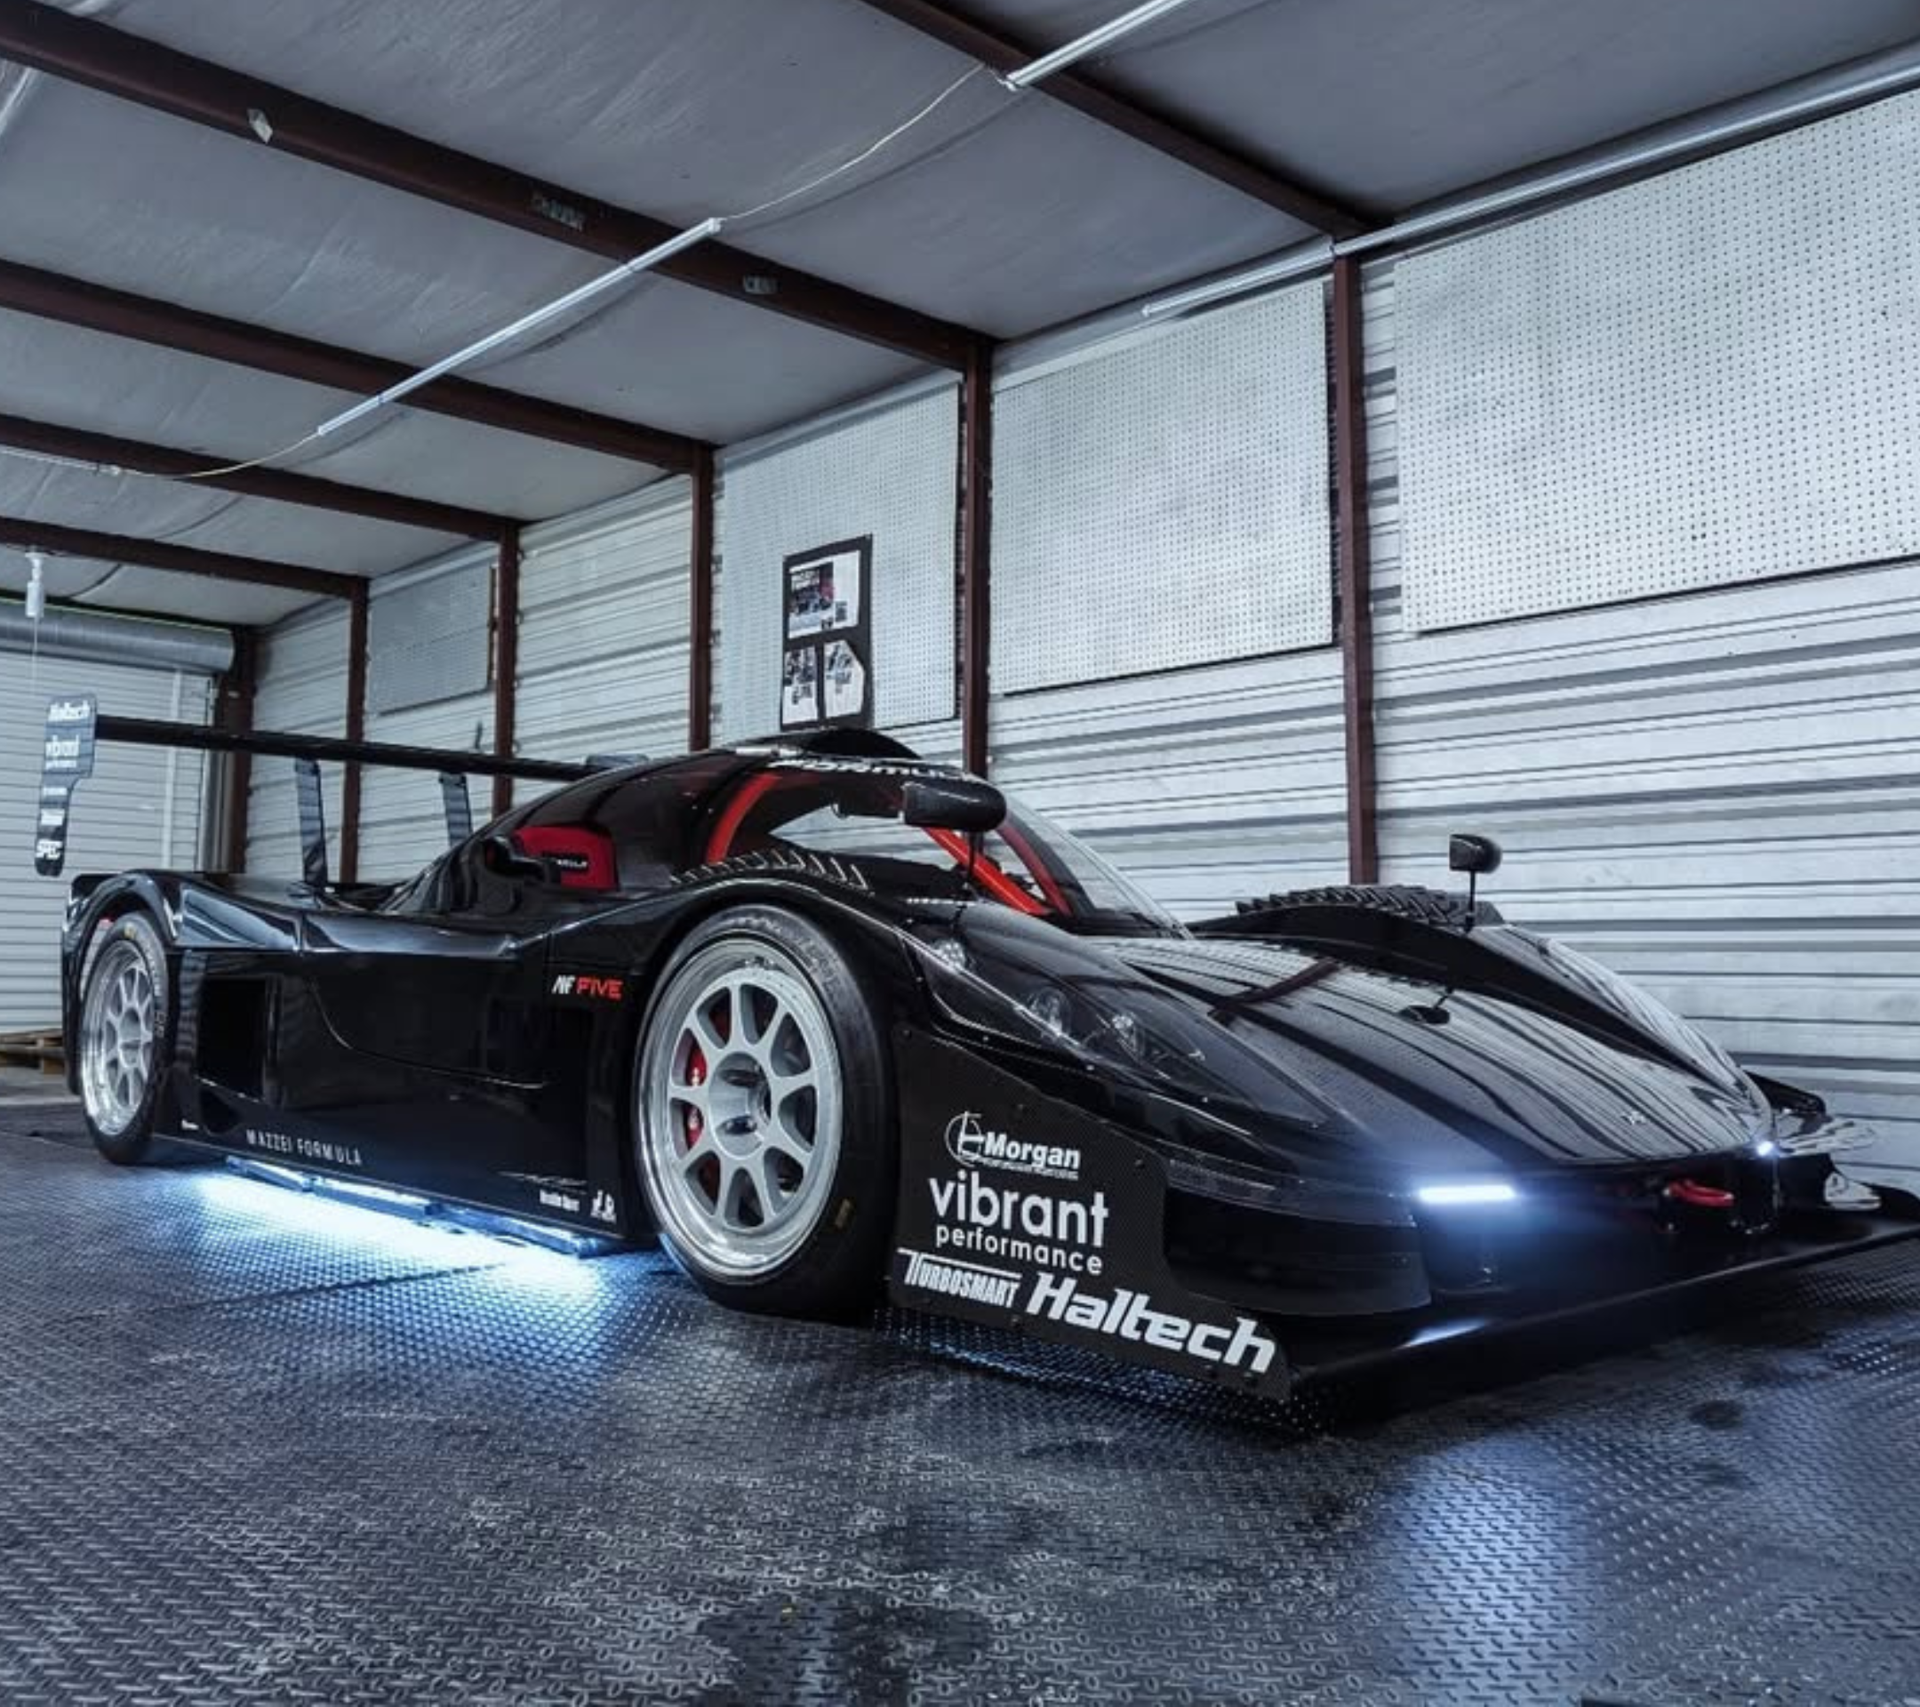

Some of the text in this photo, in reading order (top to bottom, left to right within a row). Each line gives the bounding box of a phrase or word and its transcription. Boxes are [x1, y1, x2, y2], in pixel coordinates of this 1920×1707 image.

[576, 976, 624, 1000] FIVE
[246, 1129, 363, 1166] MAZZEI FORMULA
[983, 1131, 1081, 1170] Morgan
[928, 1168, 1109, 1247] vibrant
[935, 1225, 1104, 1275] performance
[896, 1247, 1023, 1309] TURBOSMART
[1024, 1270, 1276, 1374] Haltech
